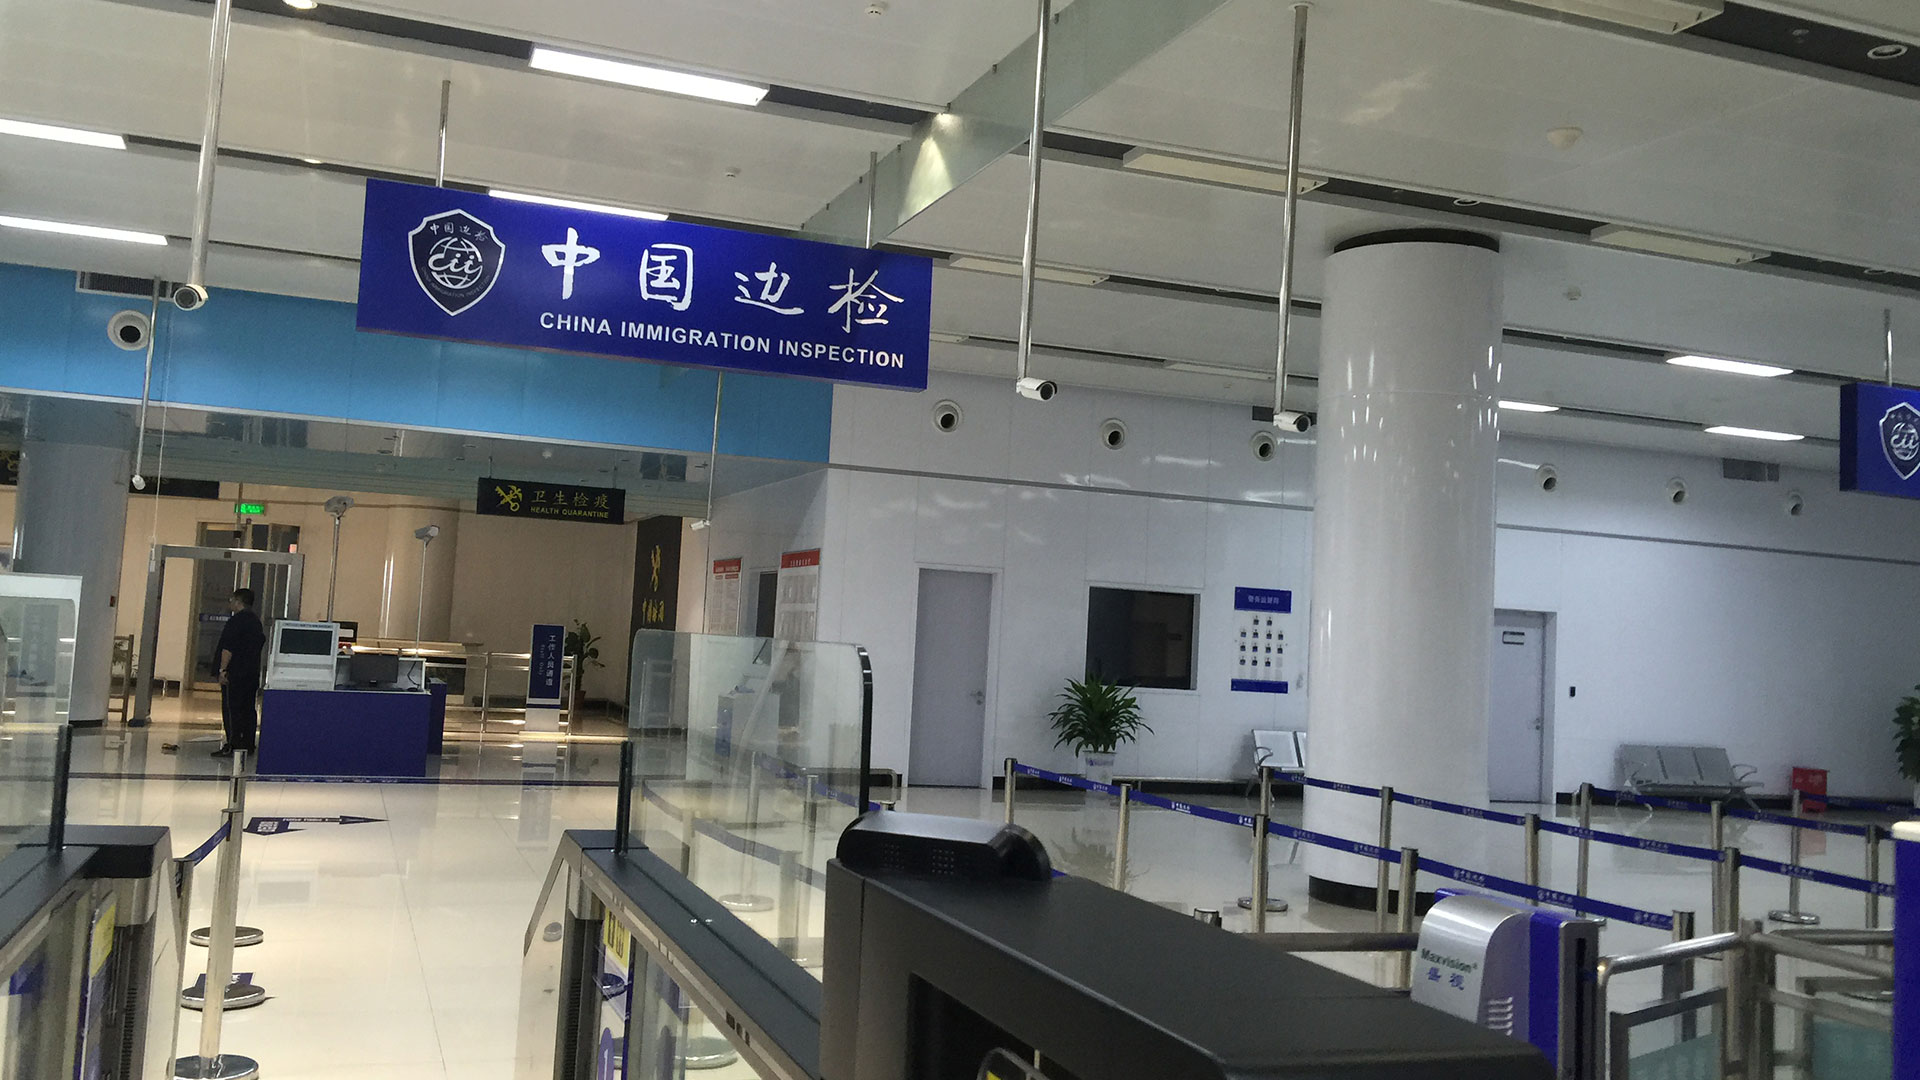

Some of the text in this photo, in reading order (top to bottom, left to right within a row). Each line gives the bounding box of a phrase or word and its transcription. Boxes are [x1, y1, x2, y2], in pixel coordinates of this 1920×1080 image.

[541, 227, 905, 334] 中国边检
[540, 311, 904, 369] CHINA IMMIGRATION INSPECTION
[530, 506, 609, 519] HEALTH QUARANTINE
[531, 489, 611, 510] 卫生检疫
